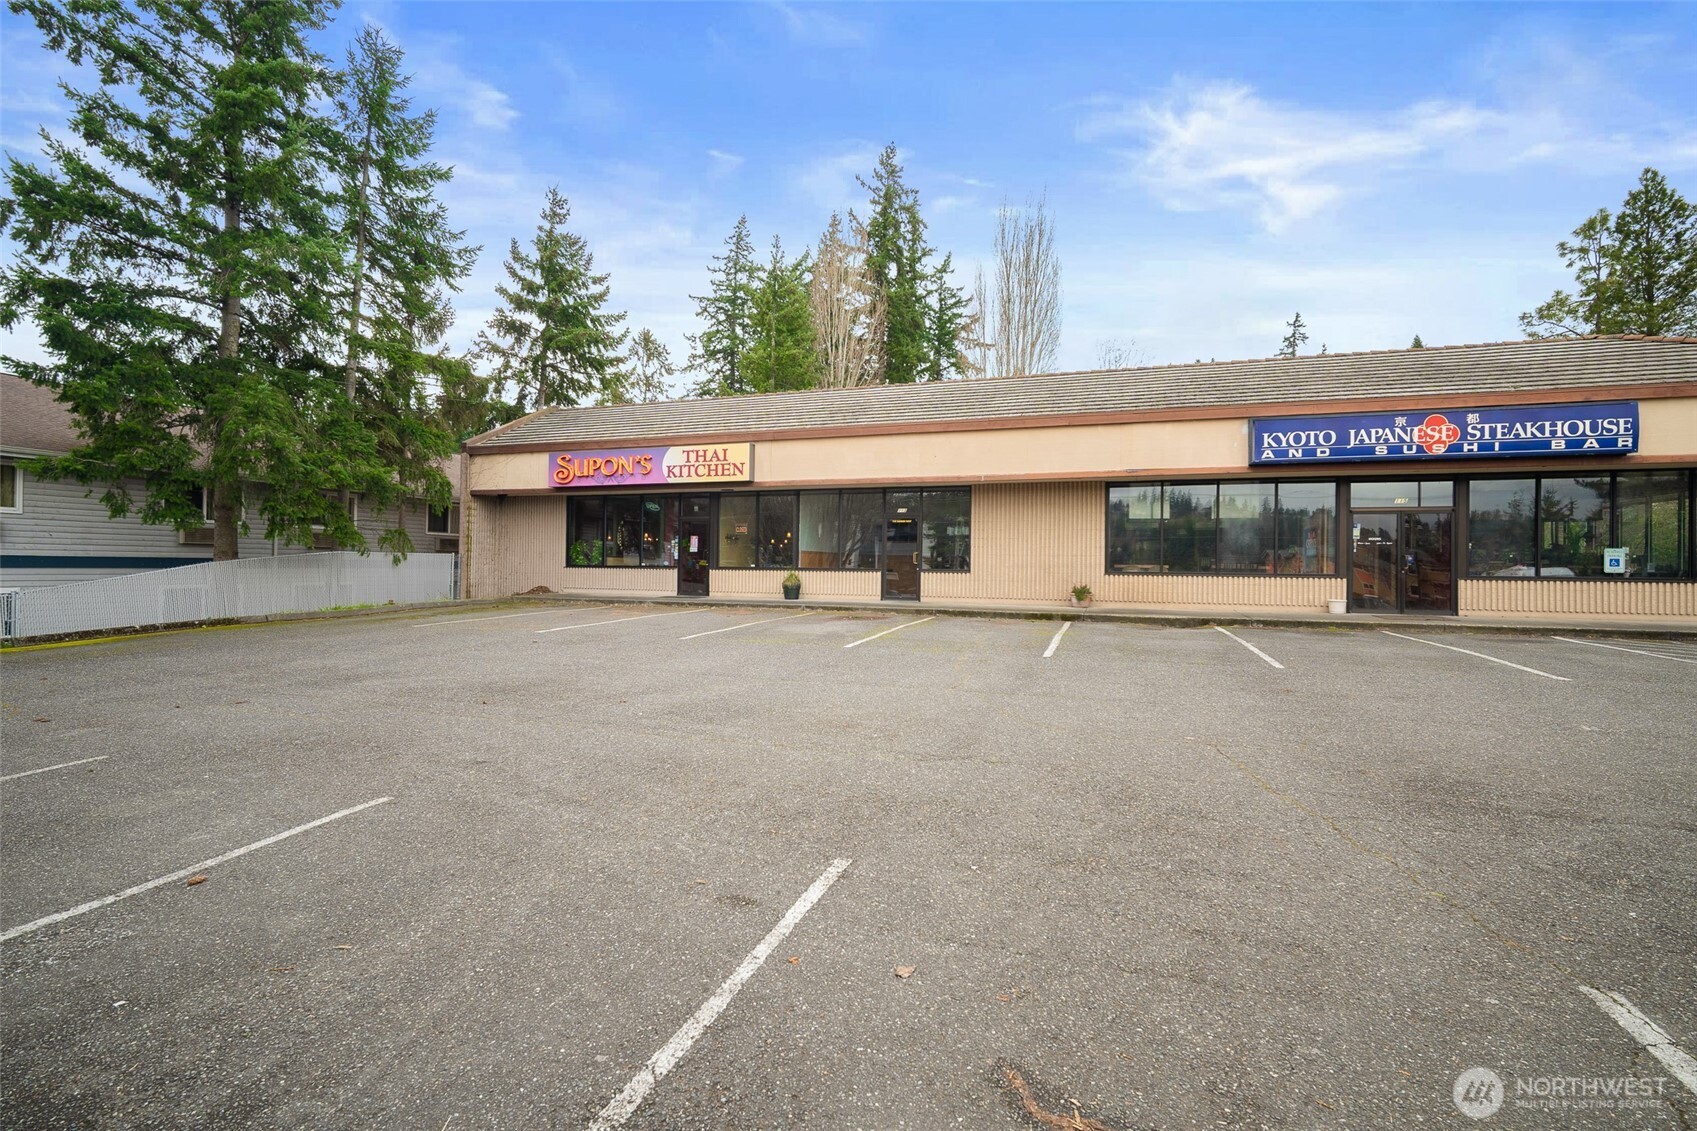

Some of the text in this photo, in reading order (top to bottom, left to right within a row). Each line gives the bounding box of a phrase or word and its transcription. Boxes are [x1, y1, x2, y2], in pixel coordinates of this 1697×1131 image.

[1262, 418, 1633, 449] KYOTO JAPANESE STEAKHOUSE
[682, 448, 729, 463] THAI
[1261, 437, 1633, 459] AND SUSHI BAR
[553, 454, 653, 485] SUPON'S
[665, 462, 746, 479] KITCHEN
